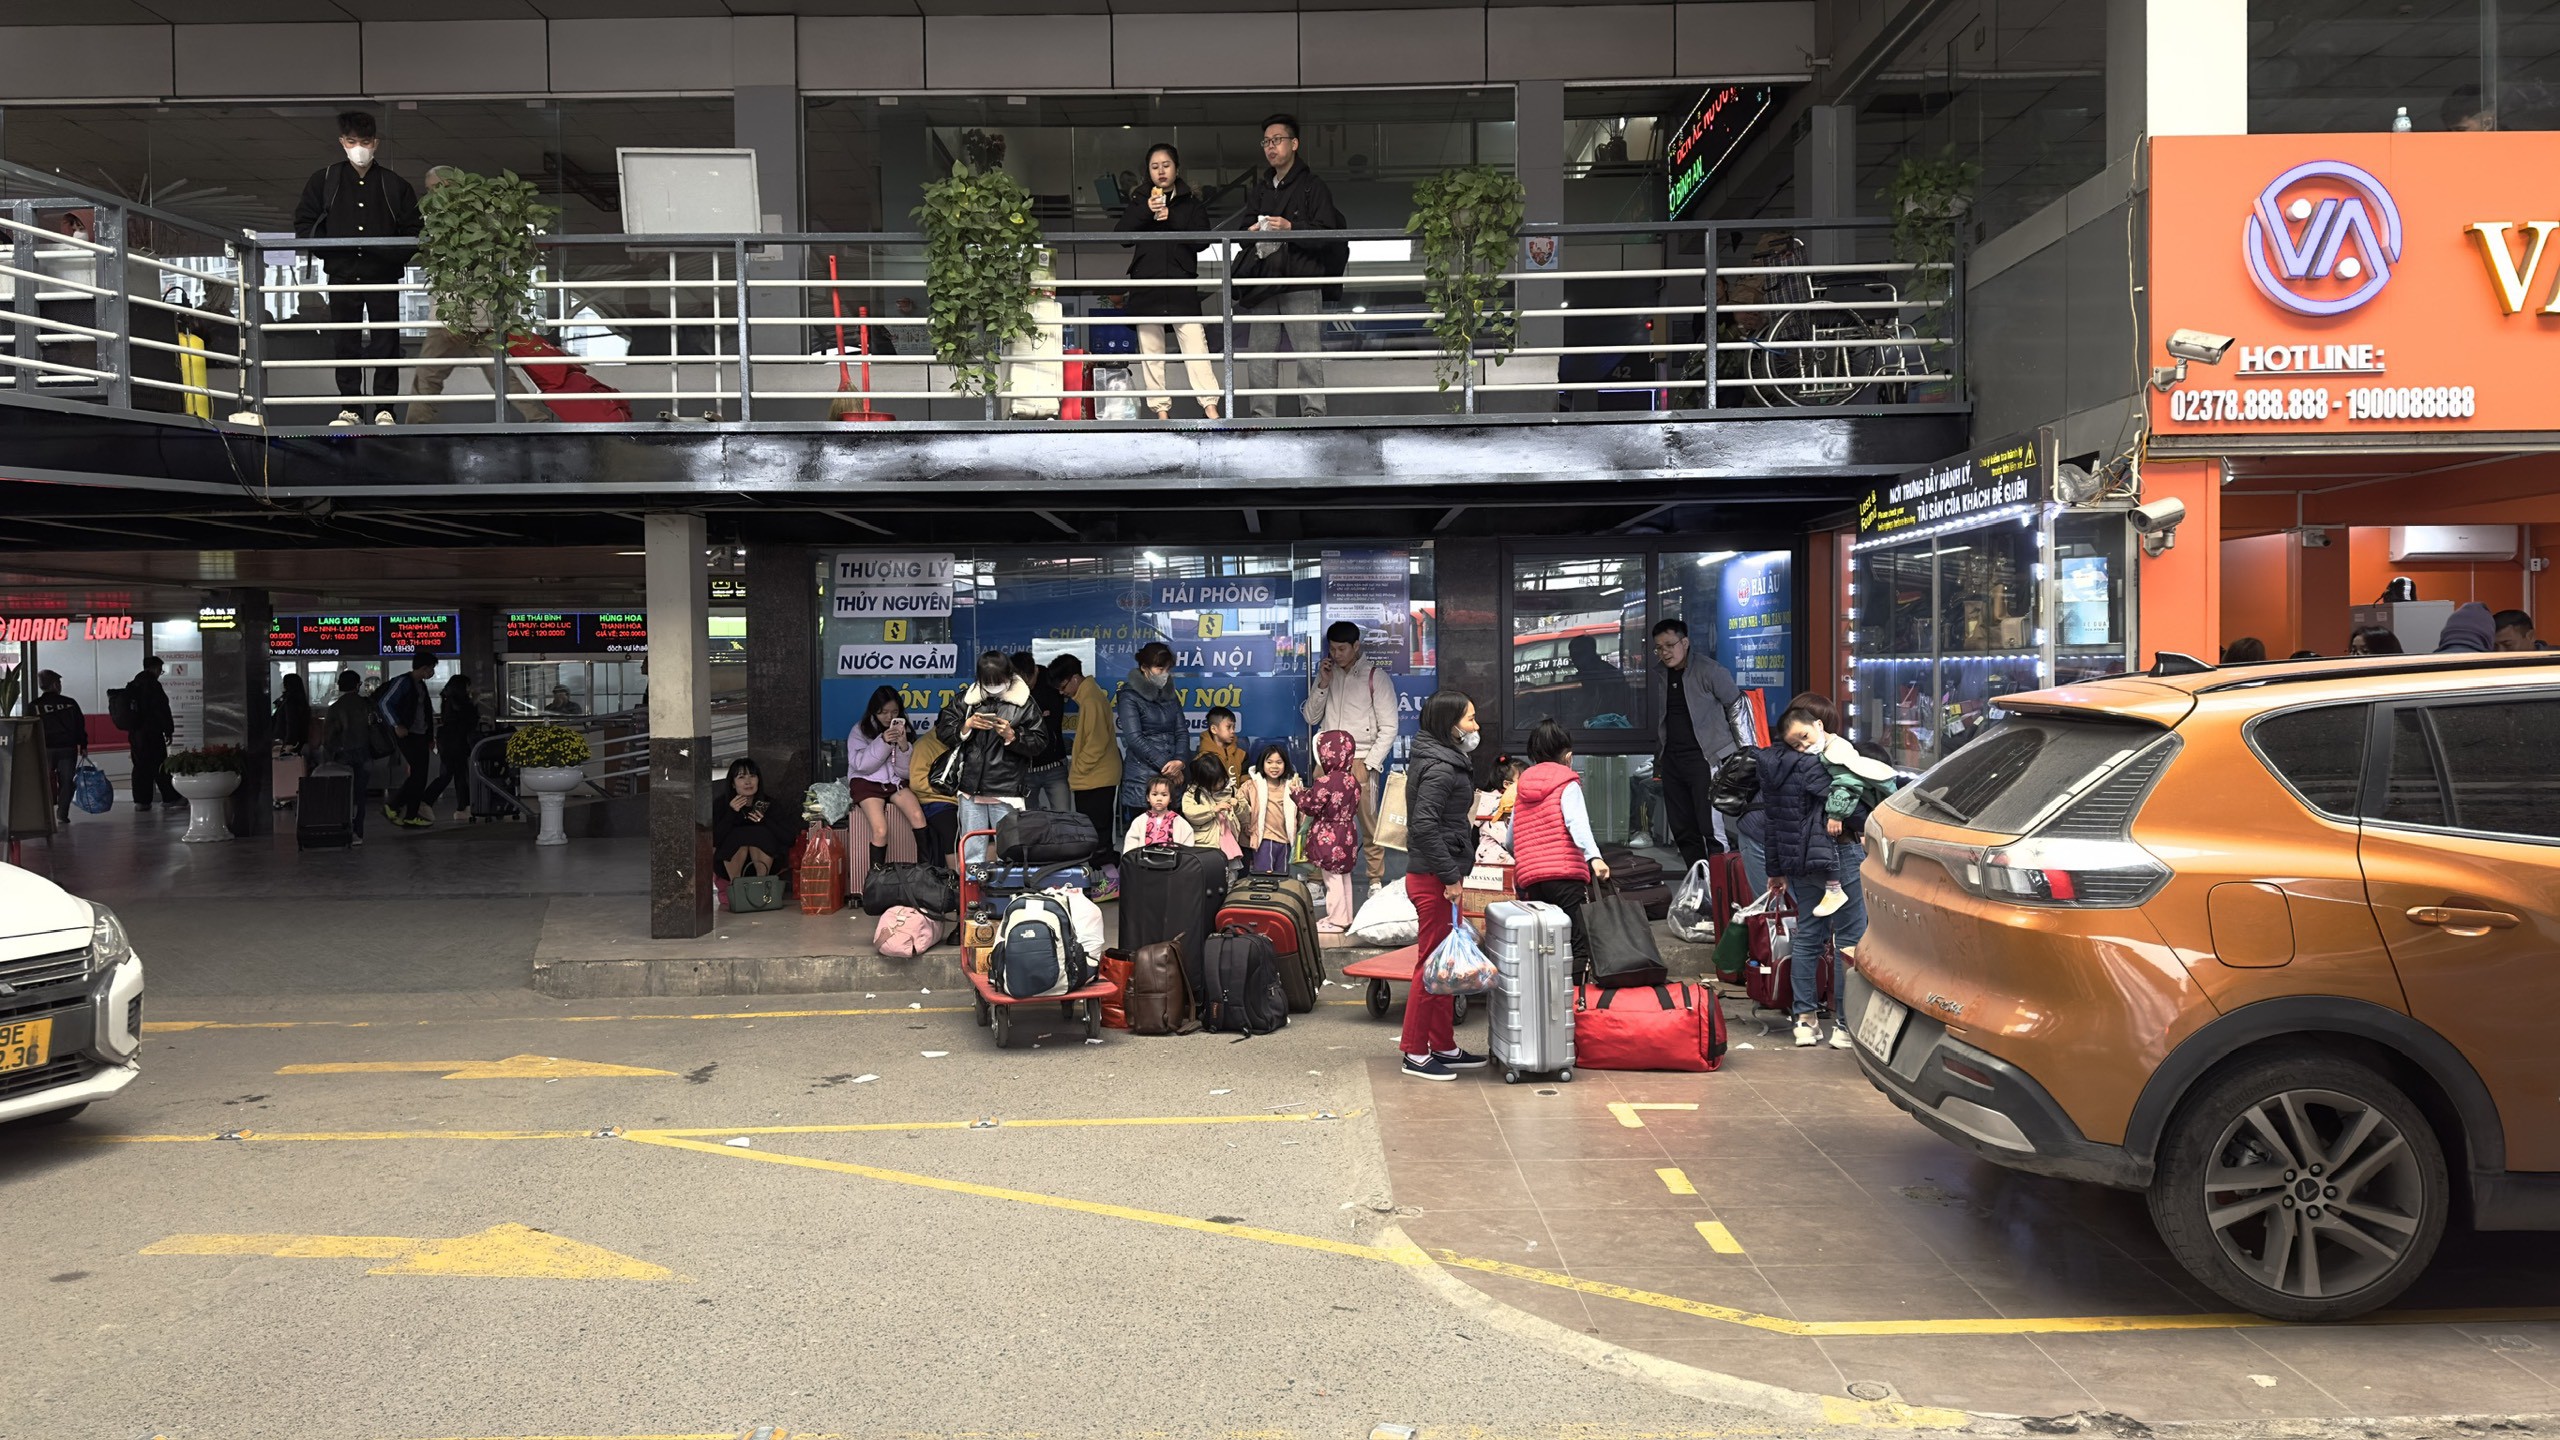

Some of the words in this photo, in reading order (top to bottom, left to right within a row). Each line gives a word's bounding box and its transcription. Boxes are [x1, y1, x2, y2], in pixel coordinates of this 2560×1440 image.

[2463, 220, 2560, 317] V
[2239, 343, 2386, 373] HOTLINE:
[2170, 387, 2329, 422] 02378.888.888
[2345, 386, 2476, 420] 1900088888
[1889, 485, 1902, 505] NƠI
[1902, 478, 1924, 501] TRƯNG
[1939, 467, 1961, 491] HÀNH
[1917, 500, 1929, 522] TÀI
[1929, 496, 1944, 520] SẢN
[1944, 490, 1961, 516] CỦA
[1962, 486, 1991, 512] KHÁCH
[1991, 475, 2003, 504] ĐỂ
[2003, 475, 2028, 503] QUÊN
[1860, 496, 1871, 516] Lost
[1861, 504, 1877, 533] Found
[840, 560, 922, 582] THƯỢNG
[928, 557, 949, 578] LÝ
[1161, 582, 1194, 604] HẢI
[1200, 582, 1270, 603] PHÒNG
[1751, 569, 1766, 596] HẢI
[1767, 569, 1781, 594] ÂU
[835, 591, 878, 611] THỦY
[882, 591, 951, 611] NGUYÊN
[318, 617, 341, 625] LANG
[1050, 624, 1077, 640] CHỈ
[1080, 624, 1112, 640] CẦN
[840, 650, 894, 670] NƯỚC
[899, 647, 955, 669] NGẦM
[1175, 646, 1205, 667] HÀ
[1212, 645, 1253, 671] NỘI
[1194, 683, 1243, 708] NƠI
[912, 717, 930, 730] vé
